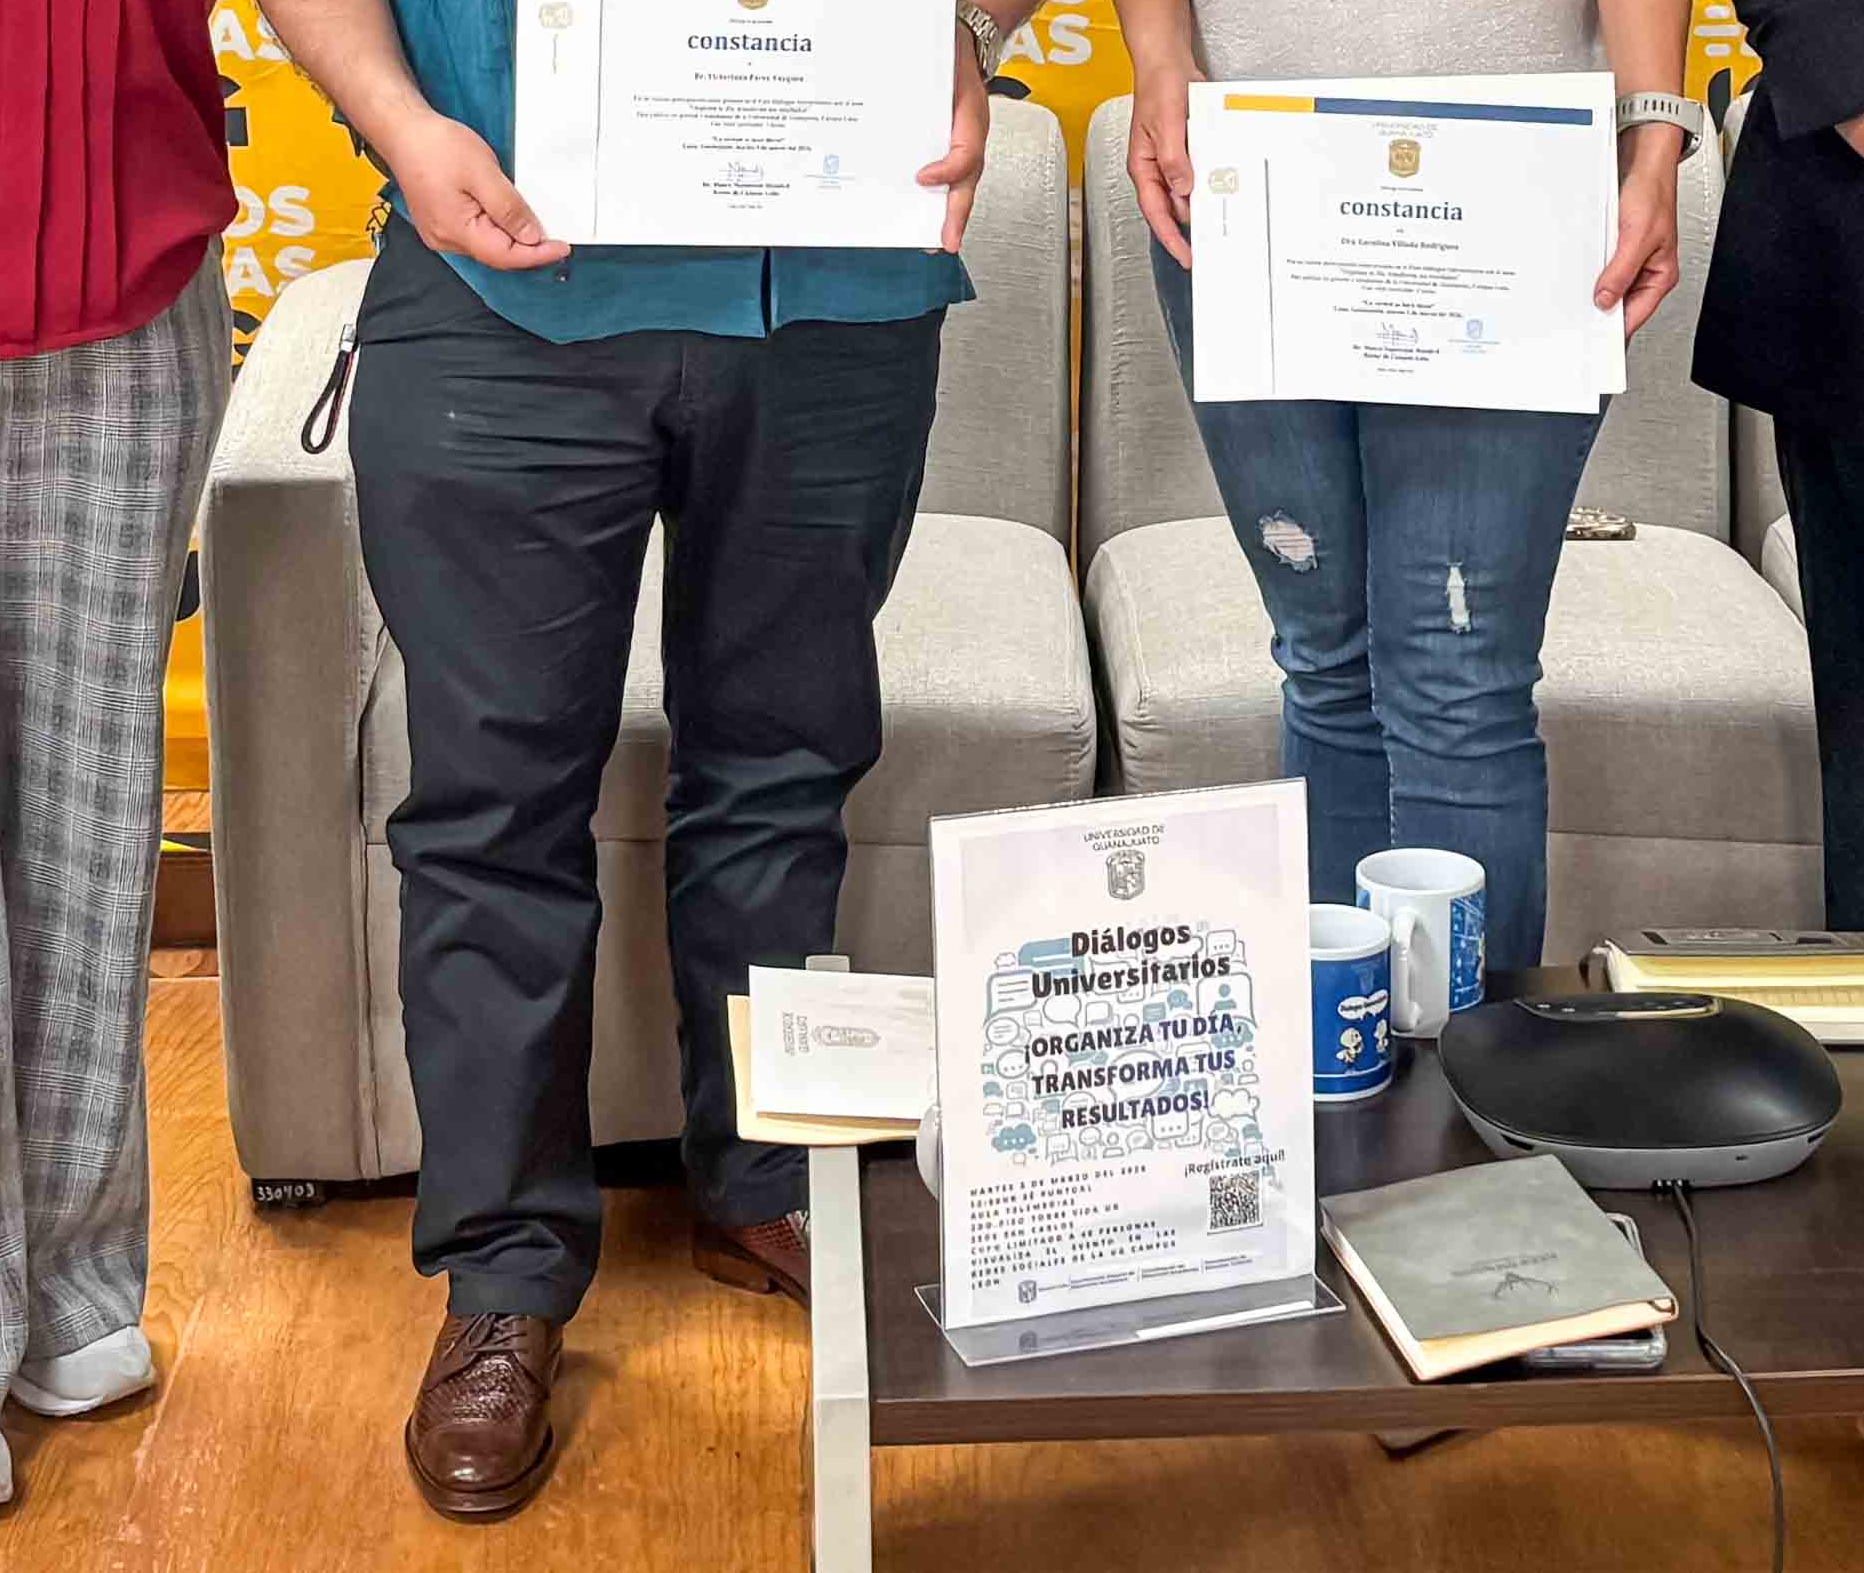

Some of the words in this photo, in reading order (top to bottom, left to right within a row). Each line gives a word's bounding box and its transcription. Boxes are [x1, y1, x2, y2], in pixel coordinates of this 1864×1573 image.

[687, 33, 813, 53] constancia
[1339, 200, 1464, 222] constancia
[1071, 925, 1190, 957] Diálogos
[1032, 952, 1230, 999] Universitarios
[1024, 1024, 1154, 1065] ¡ORGANIZA
[1159, 1017, 1187, 1041] TU
[1192, 1010, 1242, 1035] DÍA,
[1032, 1056, 1190, 1094] TRANSFORMA
[1196, 1050, 1235, 1072] TUS
[1062, 1090, 1209, 1128] RESULTADOS!
